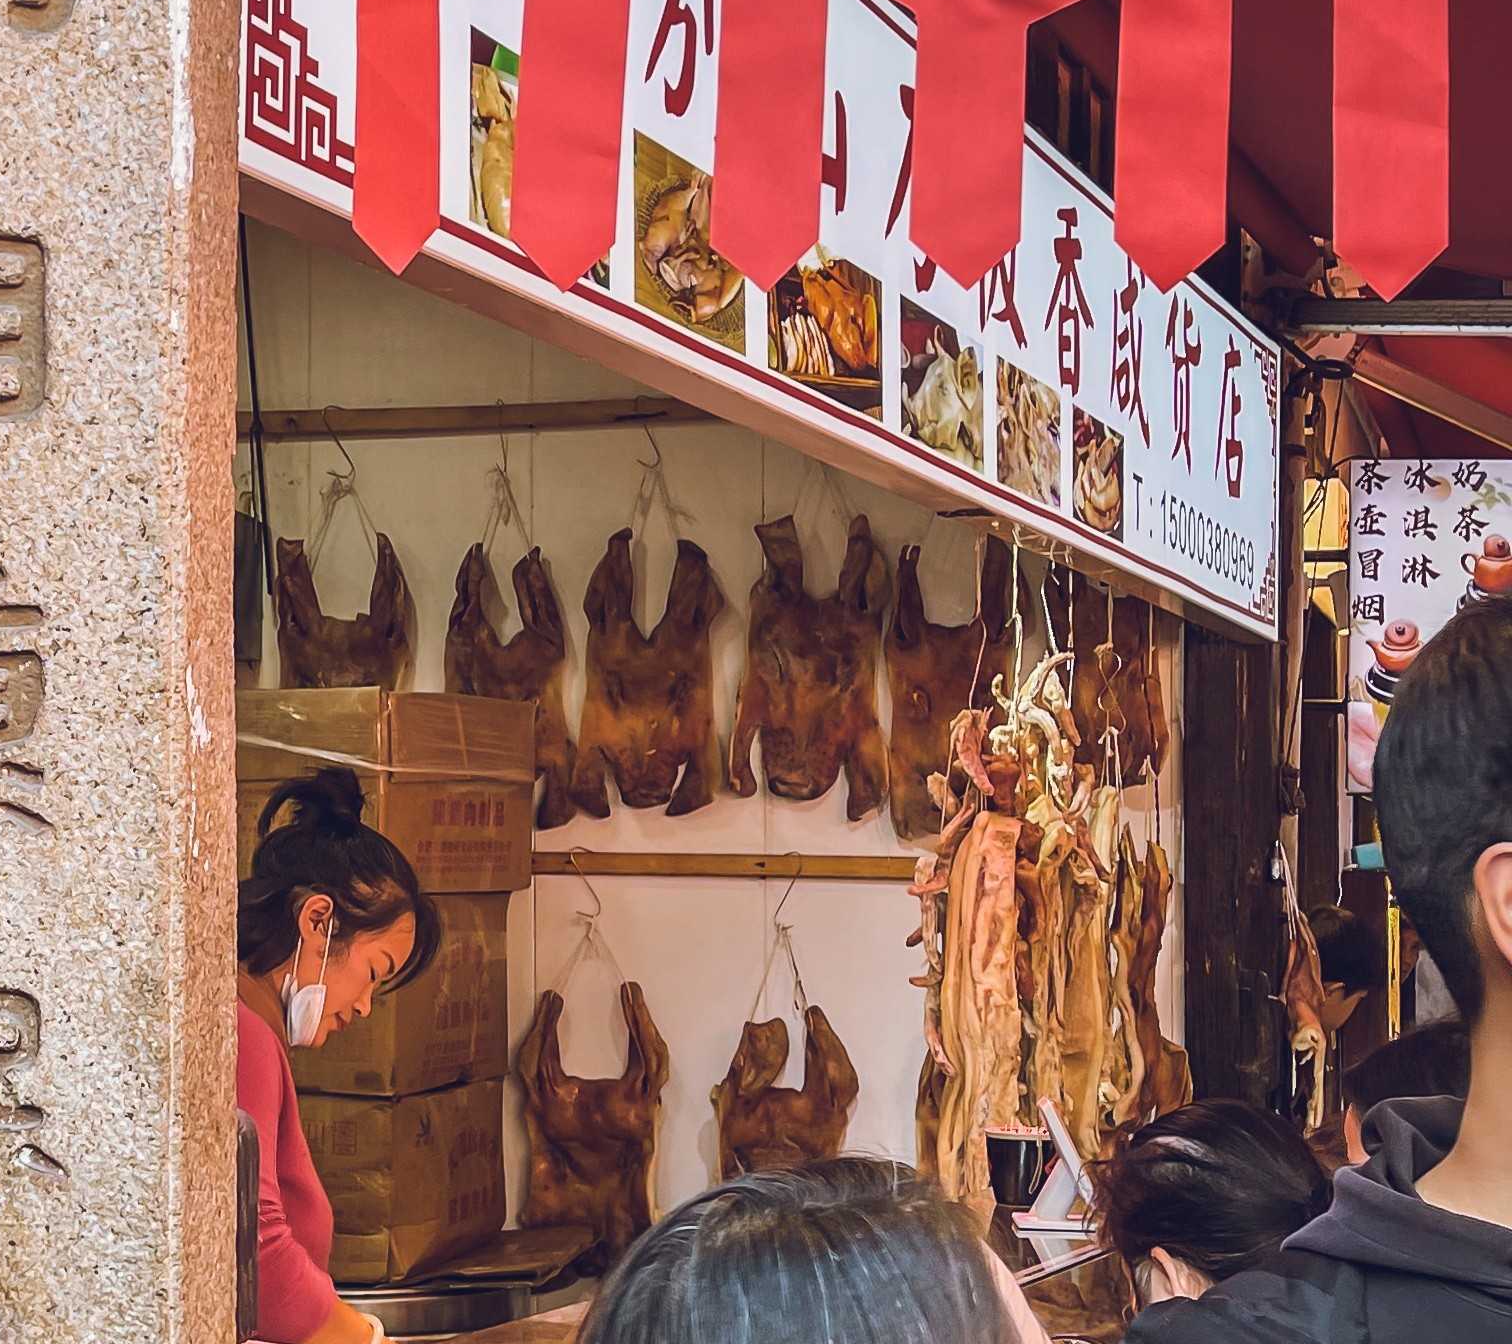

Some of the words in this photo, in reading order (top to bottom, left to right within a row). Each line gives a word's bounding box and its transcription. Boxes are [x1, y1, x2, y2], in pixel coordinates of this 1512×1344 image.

[1352, 459, 1391, 626] 茶壶冒烟
[1401, 458, 1442, 588] 冰淇淋
[1451, 461, 1490, 543] 奶茶
